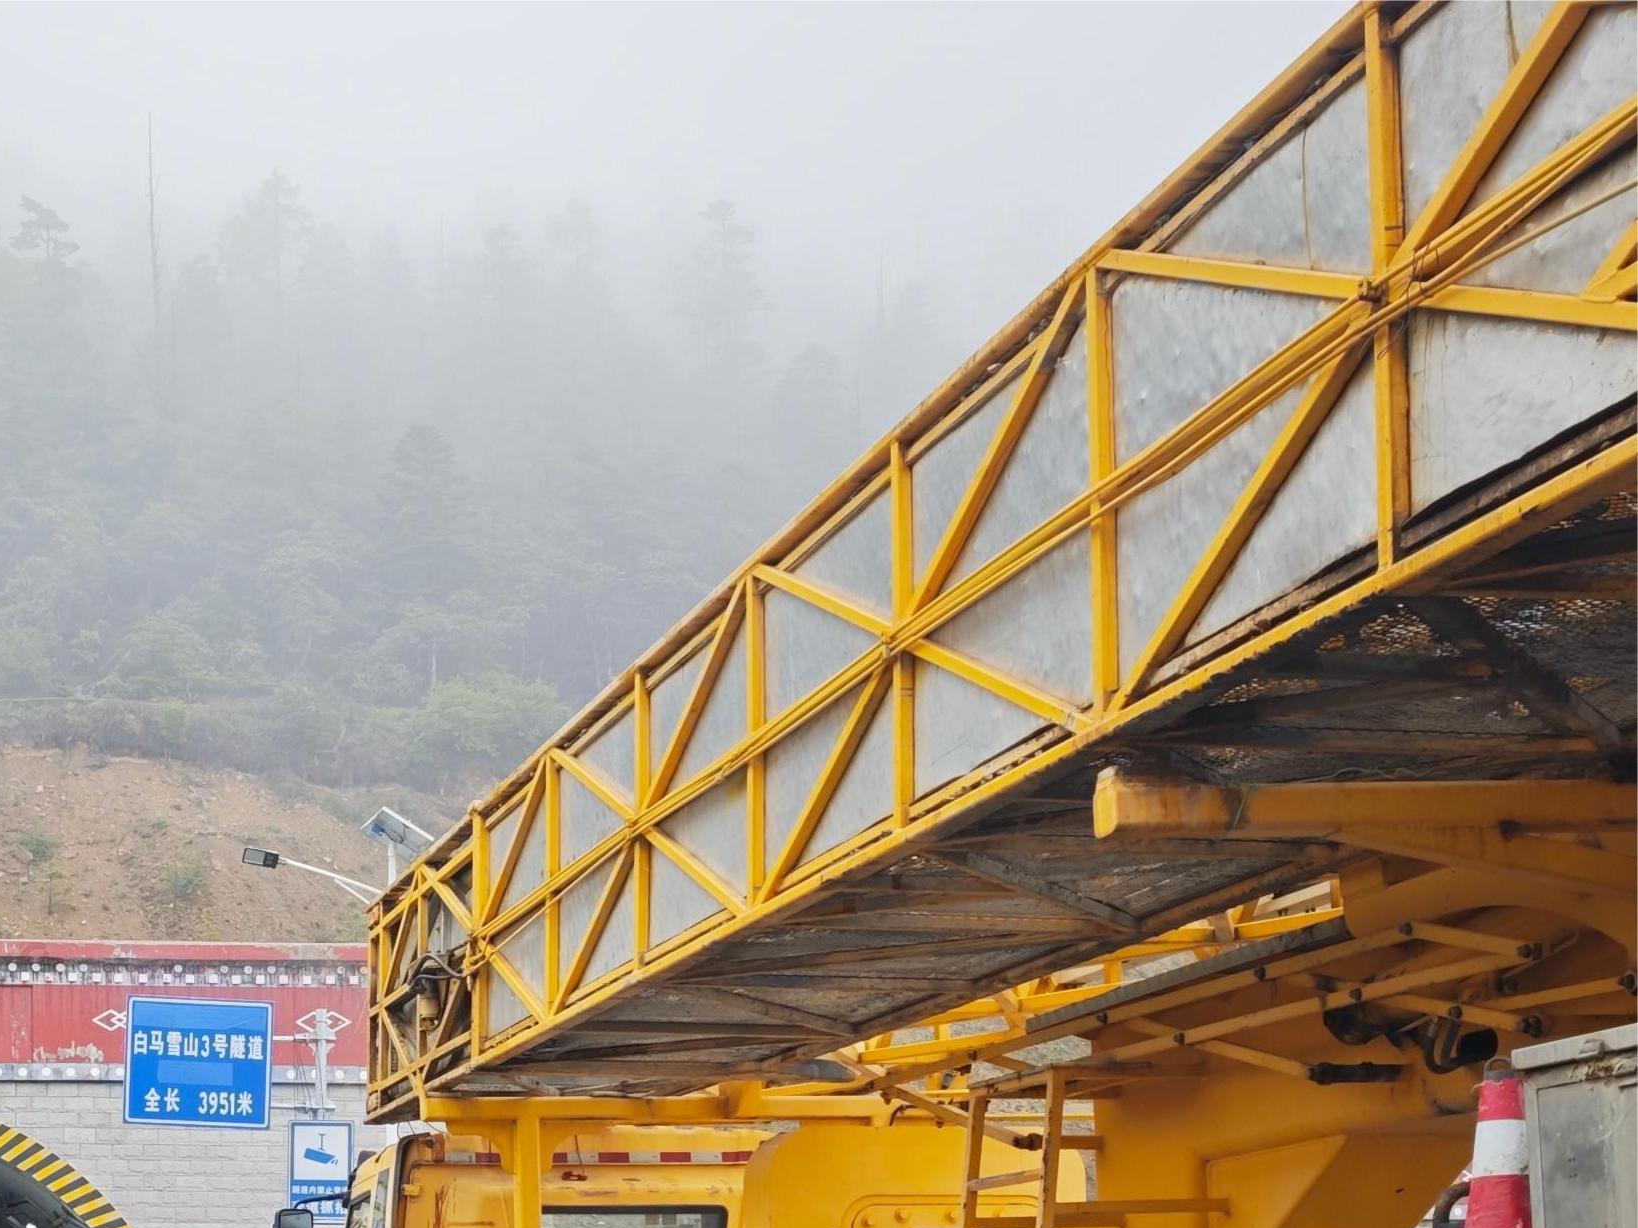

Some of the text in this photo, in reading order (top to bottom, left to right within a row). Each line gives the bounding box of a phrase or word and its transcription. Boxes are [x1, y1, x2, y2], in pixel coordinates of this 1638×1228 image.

[133, 1030, 264, 1060] 白马雪山3号隧道
[144, 1087, 253, 1116] 全长 3951米
